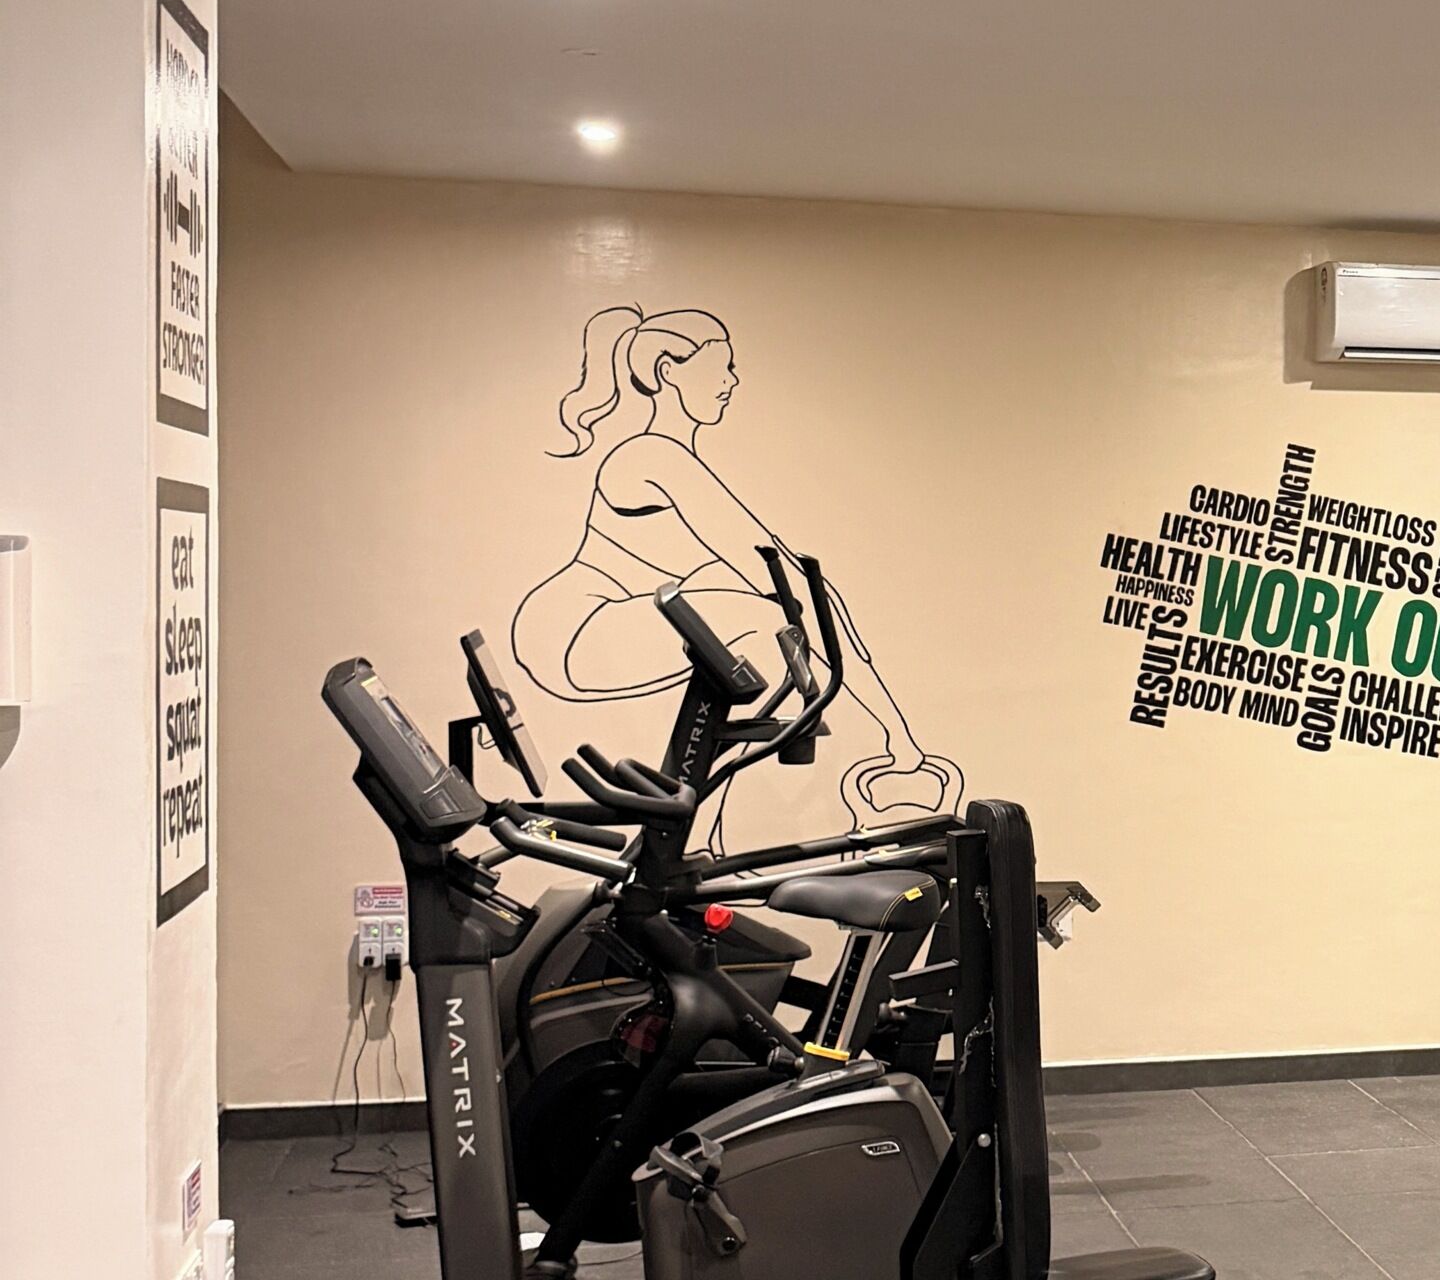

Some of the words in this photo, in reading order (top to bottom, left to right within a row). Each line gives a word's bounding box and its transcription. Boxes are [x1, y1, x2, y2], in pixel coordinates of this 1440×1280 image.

[170, 260, 200, 321] FASTER
[163, 321, 205, 386] STRONGER
[1159, 512, 1265, 560] LIFESTYLE
[1189, 484, 1271, 527] CARDIO
[1264, 443, 1316, 565] STRENGTH
[1307, 493, 1437, 547] WEIGHTLOSS
[171, 527, 194, 591] eat
[1100, 533, 1203, 586] HEALTH
[1115, 574, 1194, 607] HAPPINESS
[1296, 526, 1433, 595] FITNESS
[1102, 595, 1150, 631] LIVE
[1199, 555, 1384, 667] WORK
[165, 600, 202, 687] sleep
[1129, 605, 1188, 728] RESULTS
[1180, 635, 1309, 693] EXERCISE
[166, 687, 202, 774] squat
[1172, 676, 1237, 715] BODY
[1238, 689, 1299, 728] MIND
[1296, 663, 1345, 752] GOALS
[163, 763, 203, 858] repeat
[445, 998, 477, 1158] MATRIX
